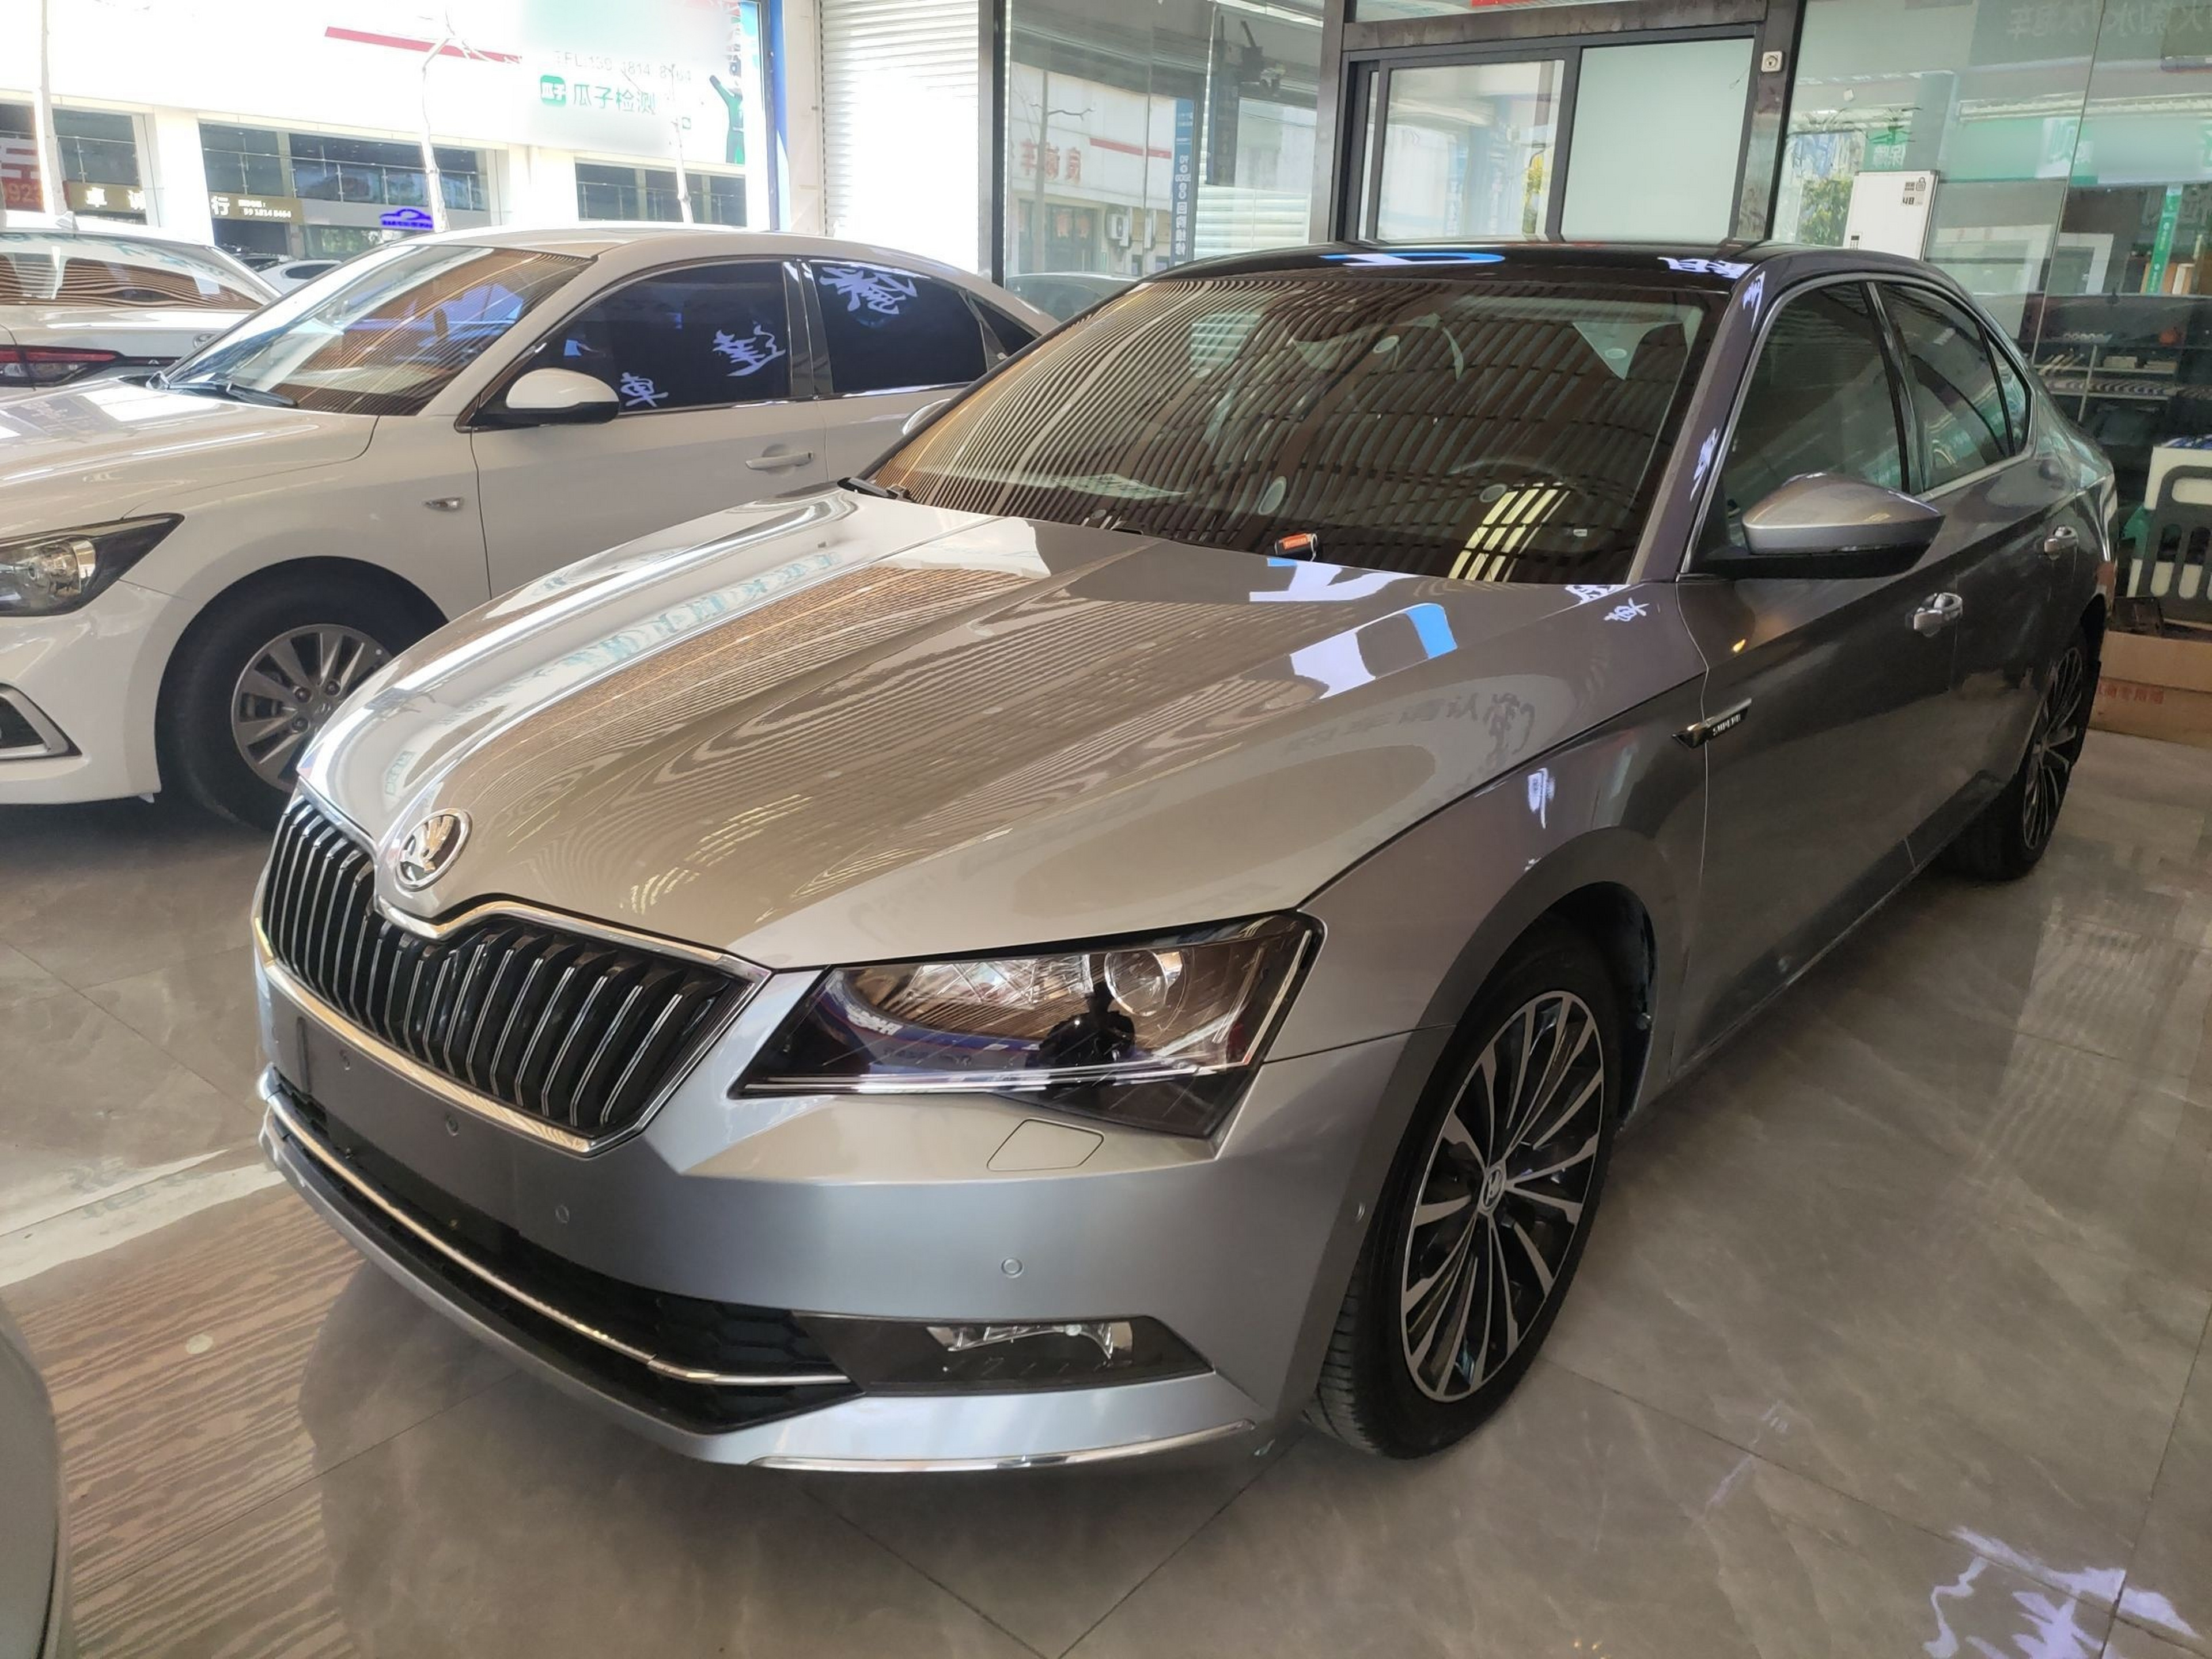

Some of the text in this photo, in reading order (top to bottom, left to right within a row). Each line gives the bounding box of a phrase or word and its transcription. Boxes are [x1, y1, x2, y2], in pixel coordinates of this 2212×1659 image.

[573, 83, 656, 115] 瓜子检测
[211, 196, 230, 215] 行
